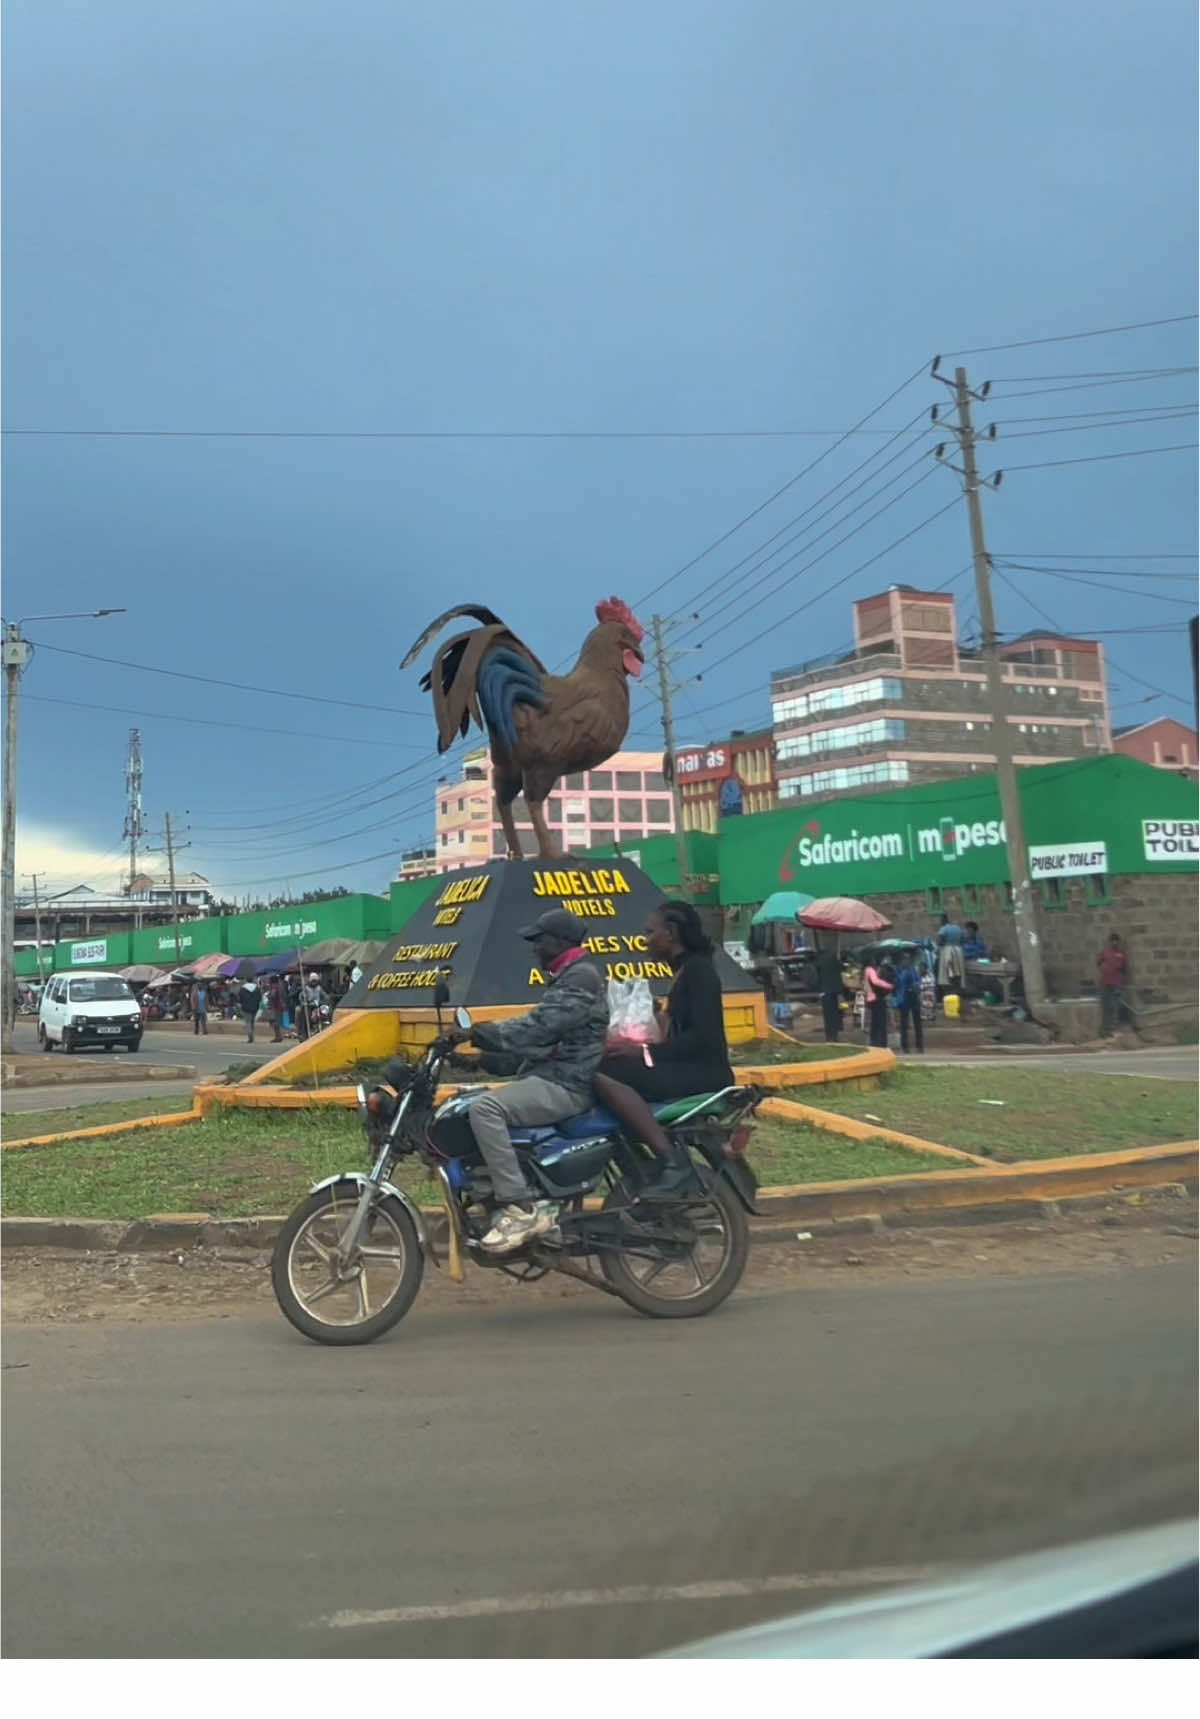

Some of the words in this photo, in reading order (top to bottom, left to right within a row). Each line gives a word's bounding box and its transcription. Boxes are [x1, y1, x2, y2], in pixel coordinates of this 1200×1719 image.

[677, 750, 724, 772] naias
[800, 829, 903, 866] Safaricom
[1031, 854, 1065, 871] PUBLIC
[1068, 852, 1105, 867] TOILET
[533, 869, 631, 896] JADELICA
[562, 898, 616, 917] HOTELS
[392, 941, 459, 962] RESTAURANT
